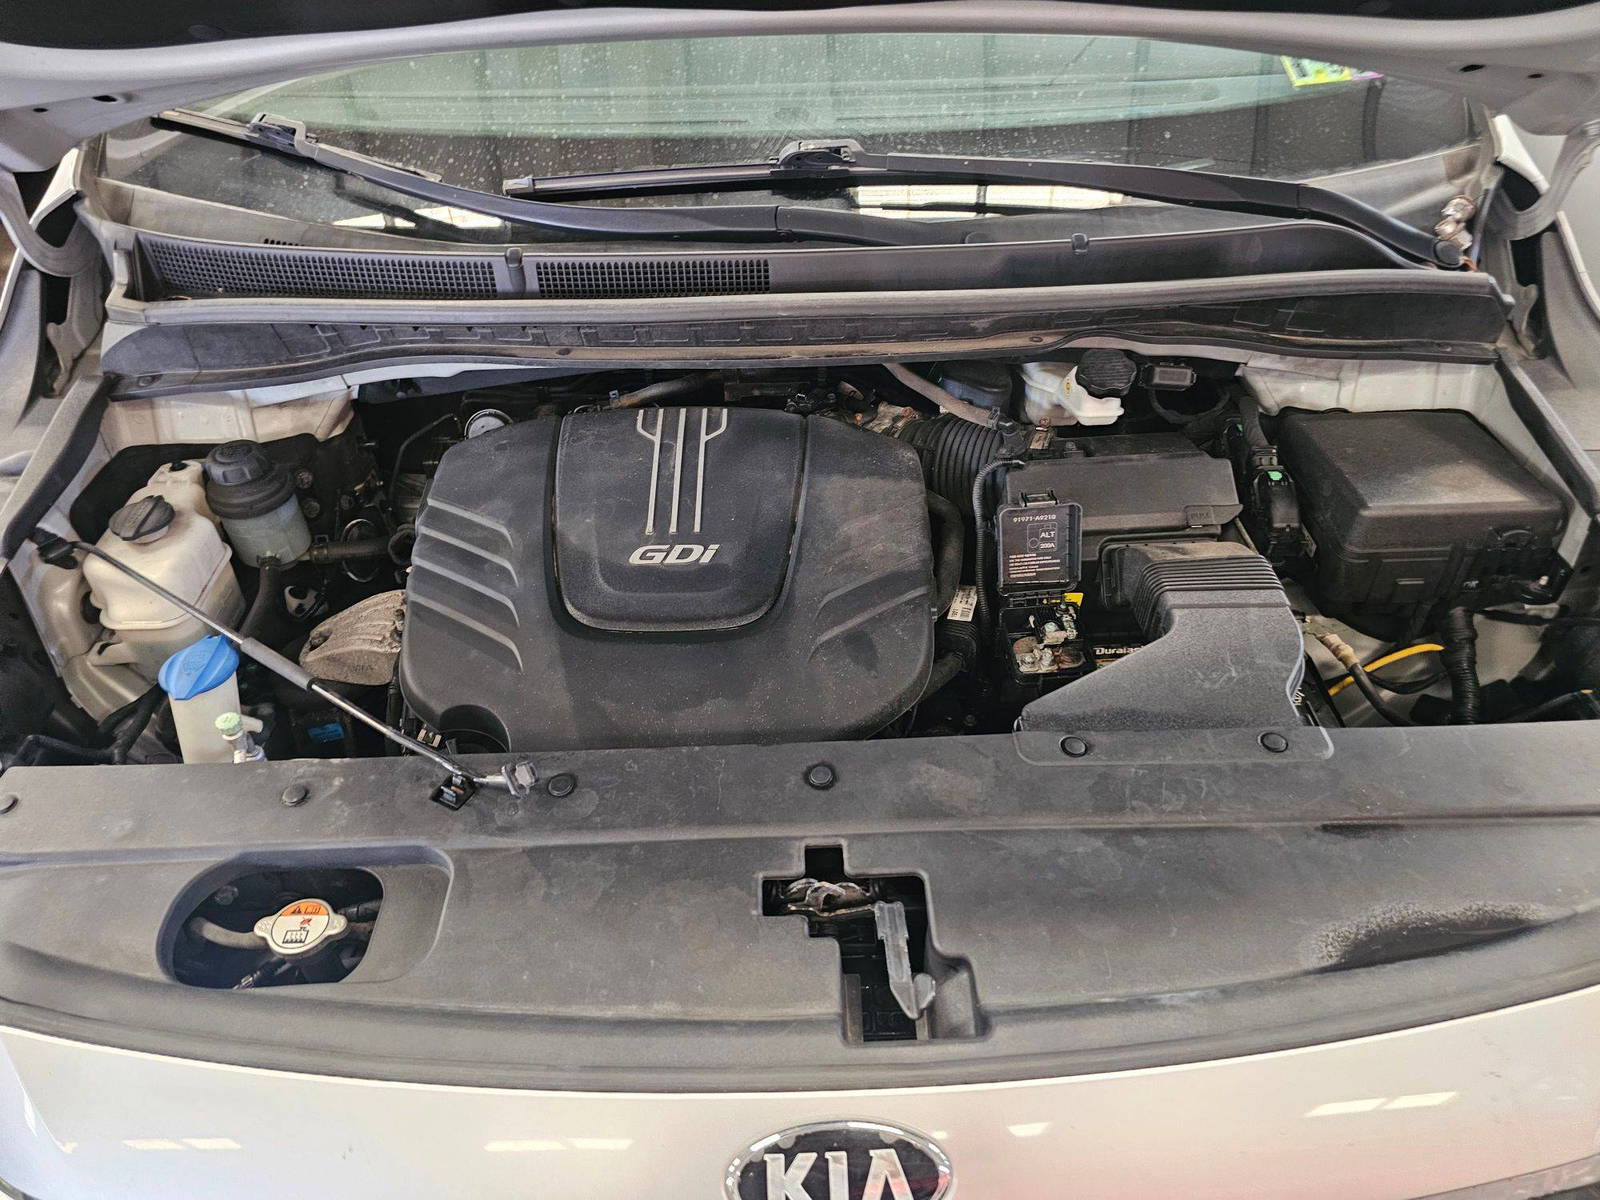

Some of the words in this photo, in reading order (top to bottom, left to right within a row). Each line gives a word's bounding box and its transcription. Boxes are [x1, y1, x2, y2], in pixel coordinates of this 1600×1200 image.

[629, 544, 720, 565] GDi
[1093, 646, 1144, 655] Durala
[763, 1148, 914, 1200] KIA
